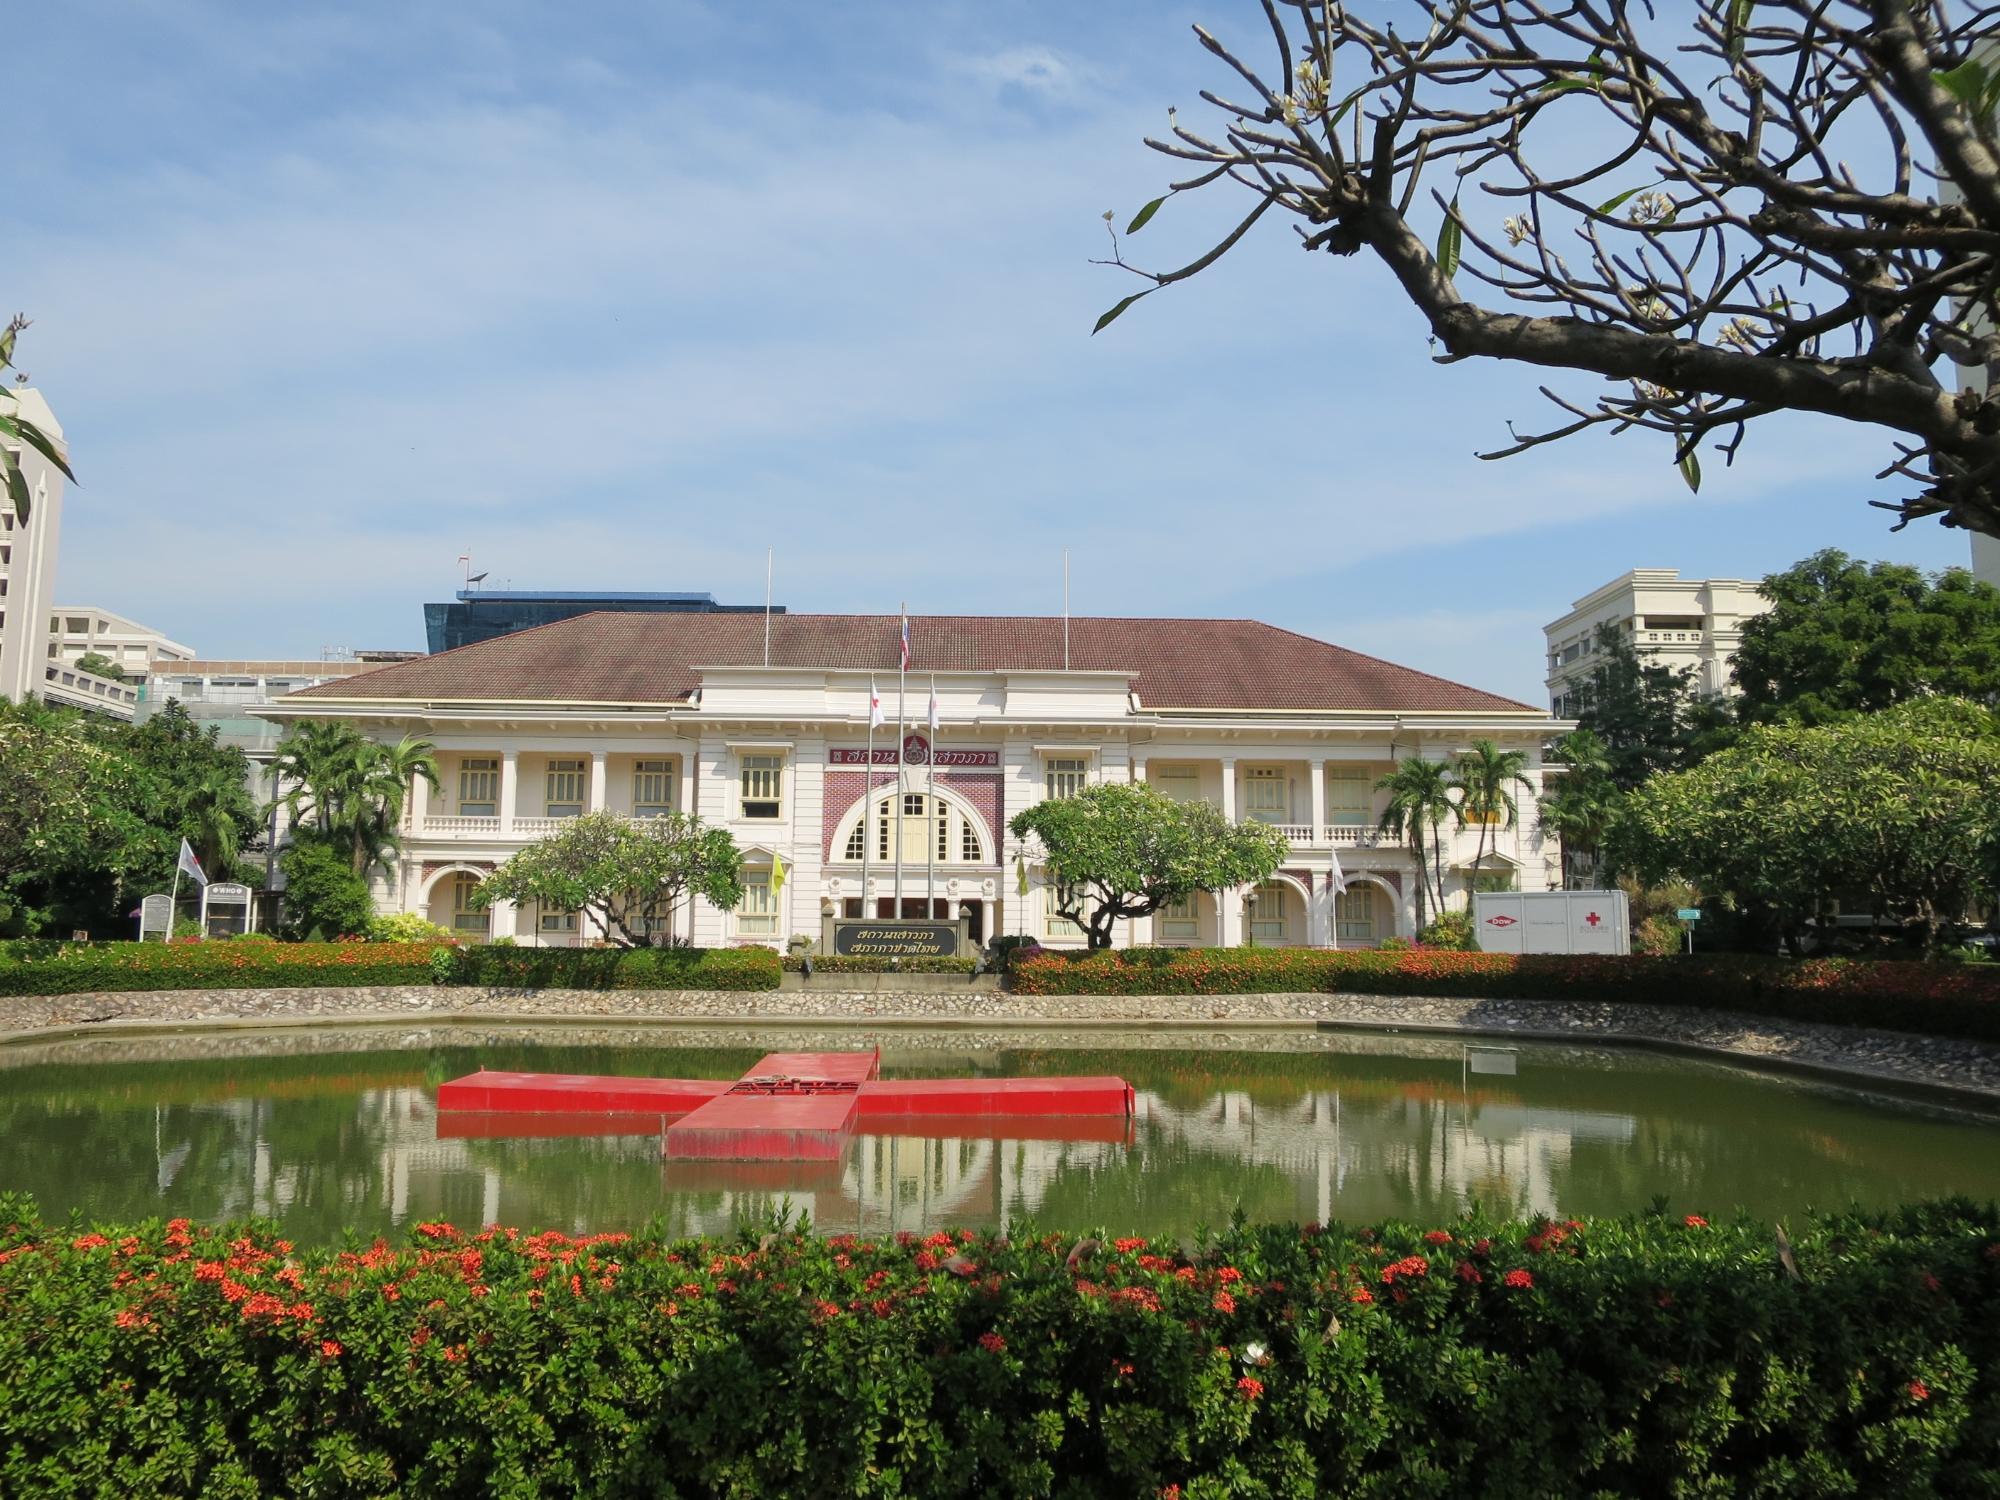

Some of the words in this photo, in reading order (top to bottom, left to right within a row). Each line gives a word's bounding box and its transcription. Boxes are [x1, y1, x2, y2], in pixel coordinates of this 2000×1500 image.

[857, 929, 935, 940] สถานเสาวภา
[850, 941, 940, 953] สภากาชาดไทย
